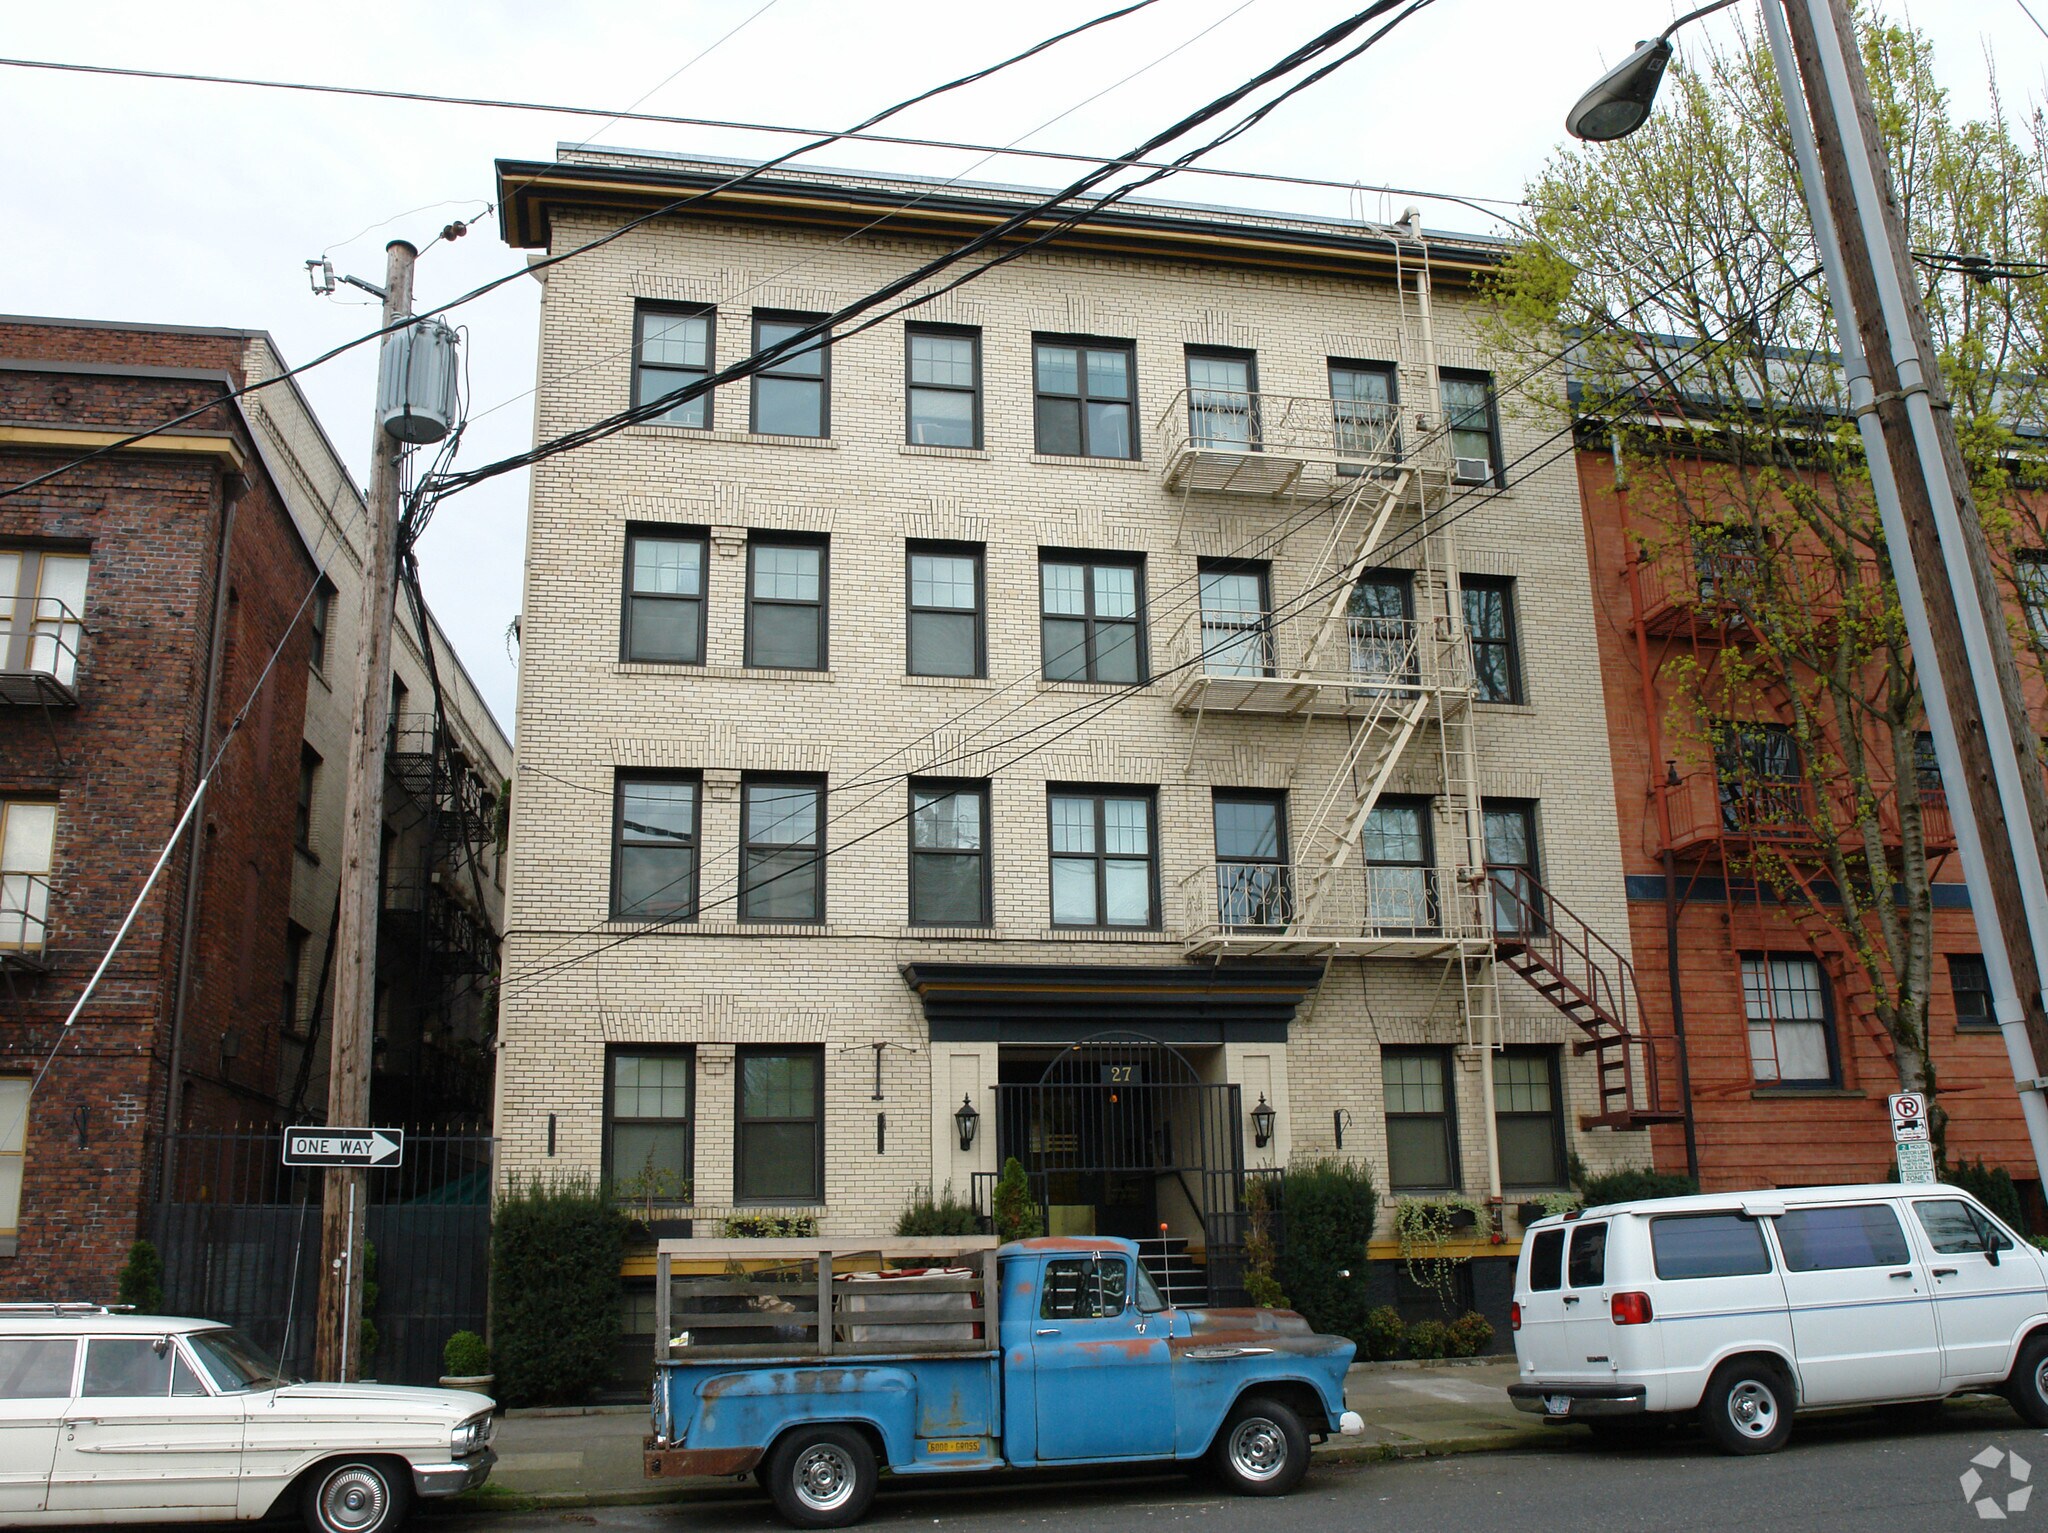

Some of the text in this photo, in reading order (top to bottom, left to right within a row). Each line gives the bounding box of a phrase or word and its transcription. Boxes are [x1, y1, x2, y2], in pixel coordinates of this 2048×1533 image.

[1111, 1066, 1132, 1082] 27
[297, 1139, 374, 1154] ONE WAY
